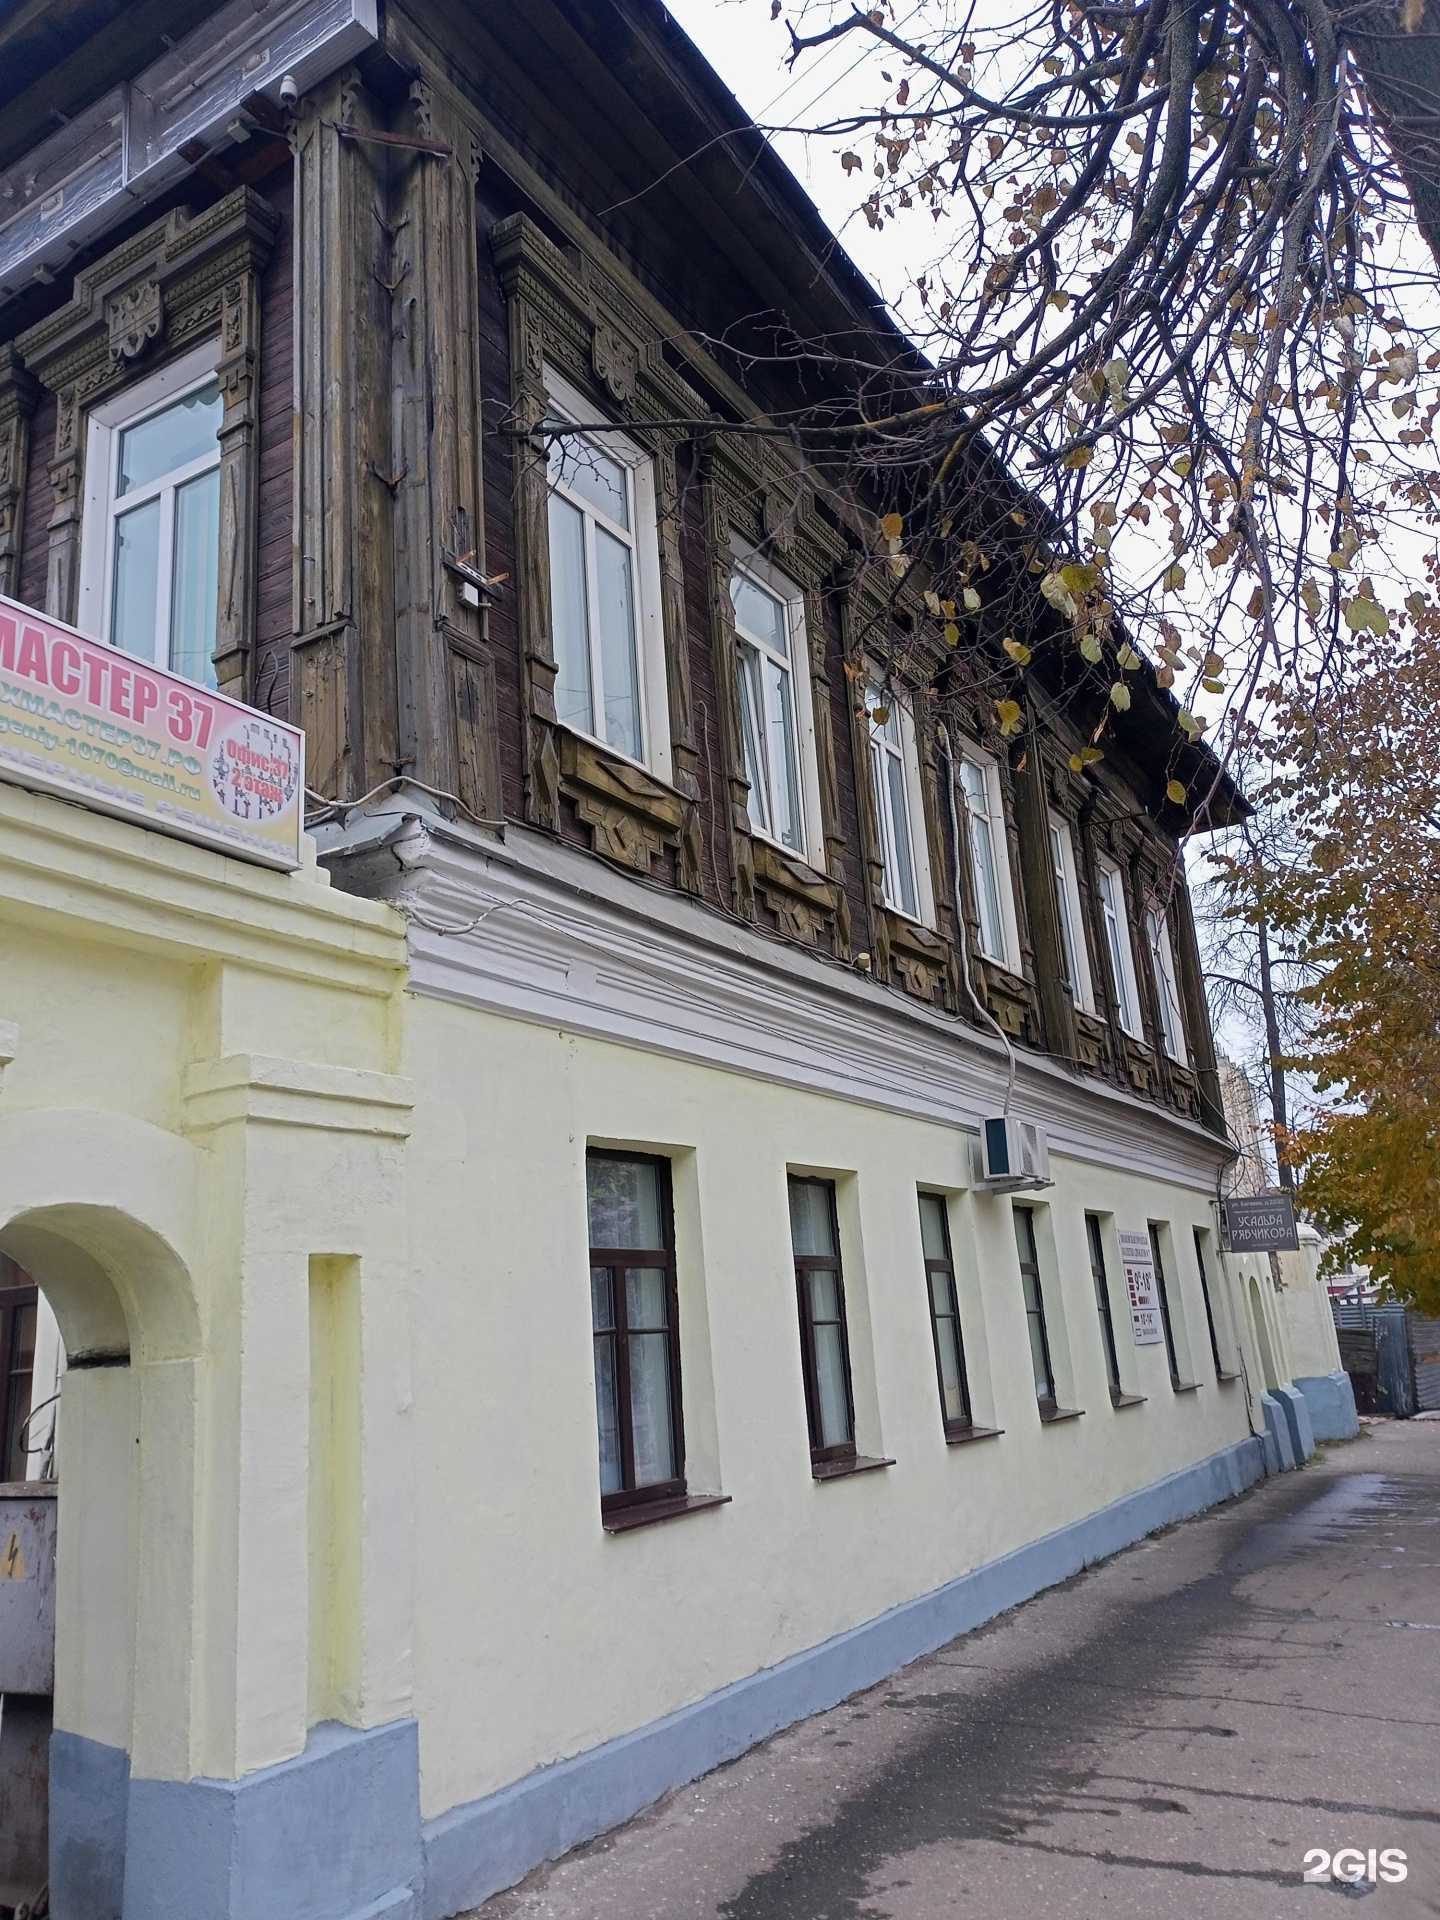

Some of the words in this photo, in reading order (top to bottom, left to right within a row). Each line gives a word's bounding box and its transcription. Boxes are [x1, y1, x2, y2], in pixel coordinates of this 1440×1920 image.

[168, 690, 213, 749] 37
[231, 768, 241, 787] 2
[1238, 1214, 1283, 1227] УСАДЬБА
